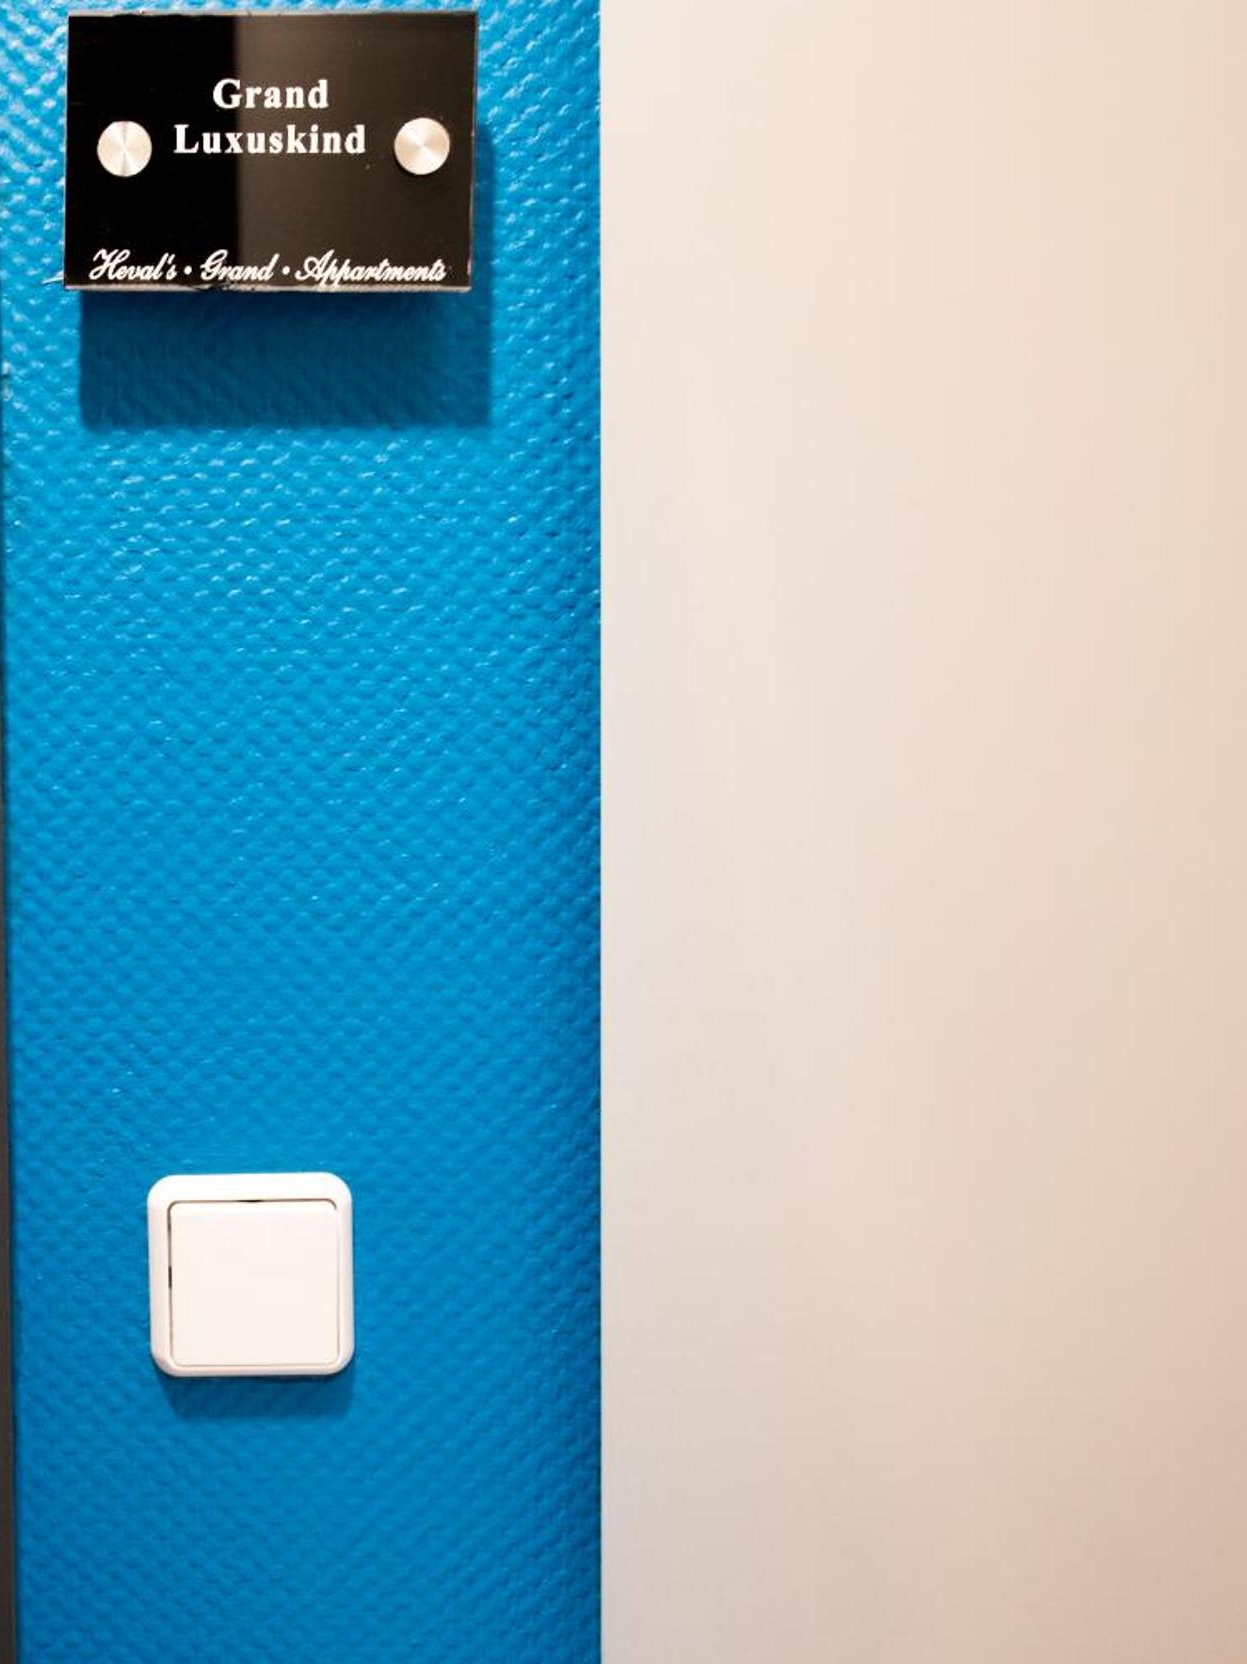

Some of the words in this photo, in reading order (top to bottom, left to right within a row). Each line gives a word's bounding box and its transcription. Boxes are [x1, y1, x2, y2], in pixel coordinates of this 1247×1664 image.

[213, 78, 329, 109] Grand
[174, 124, 366, 155] Luxuskind
[89, 249, 177, 281] Heval's
[200, 249, 279, 282] Grand
[296, 251, 446, 288] Appartments
